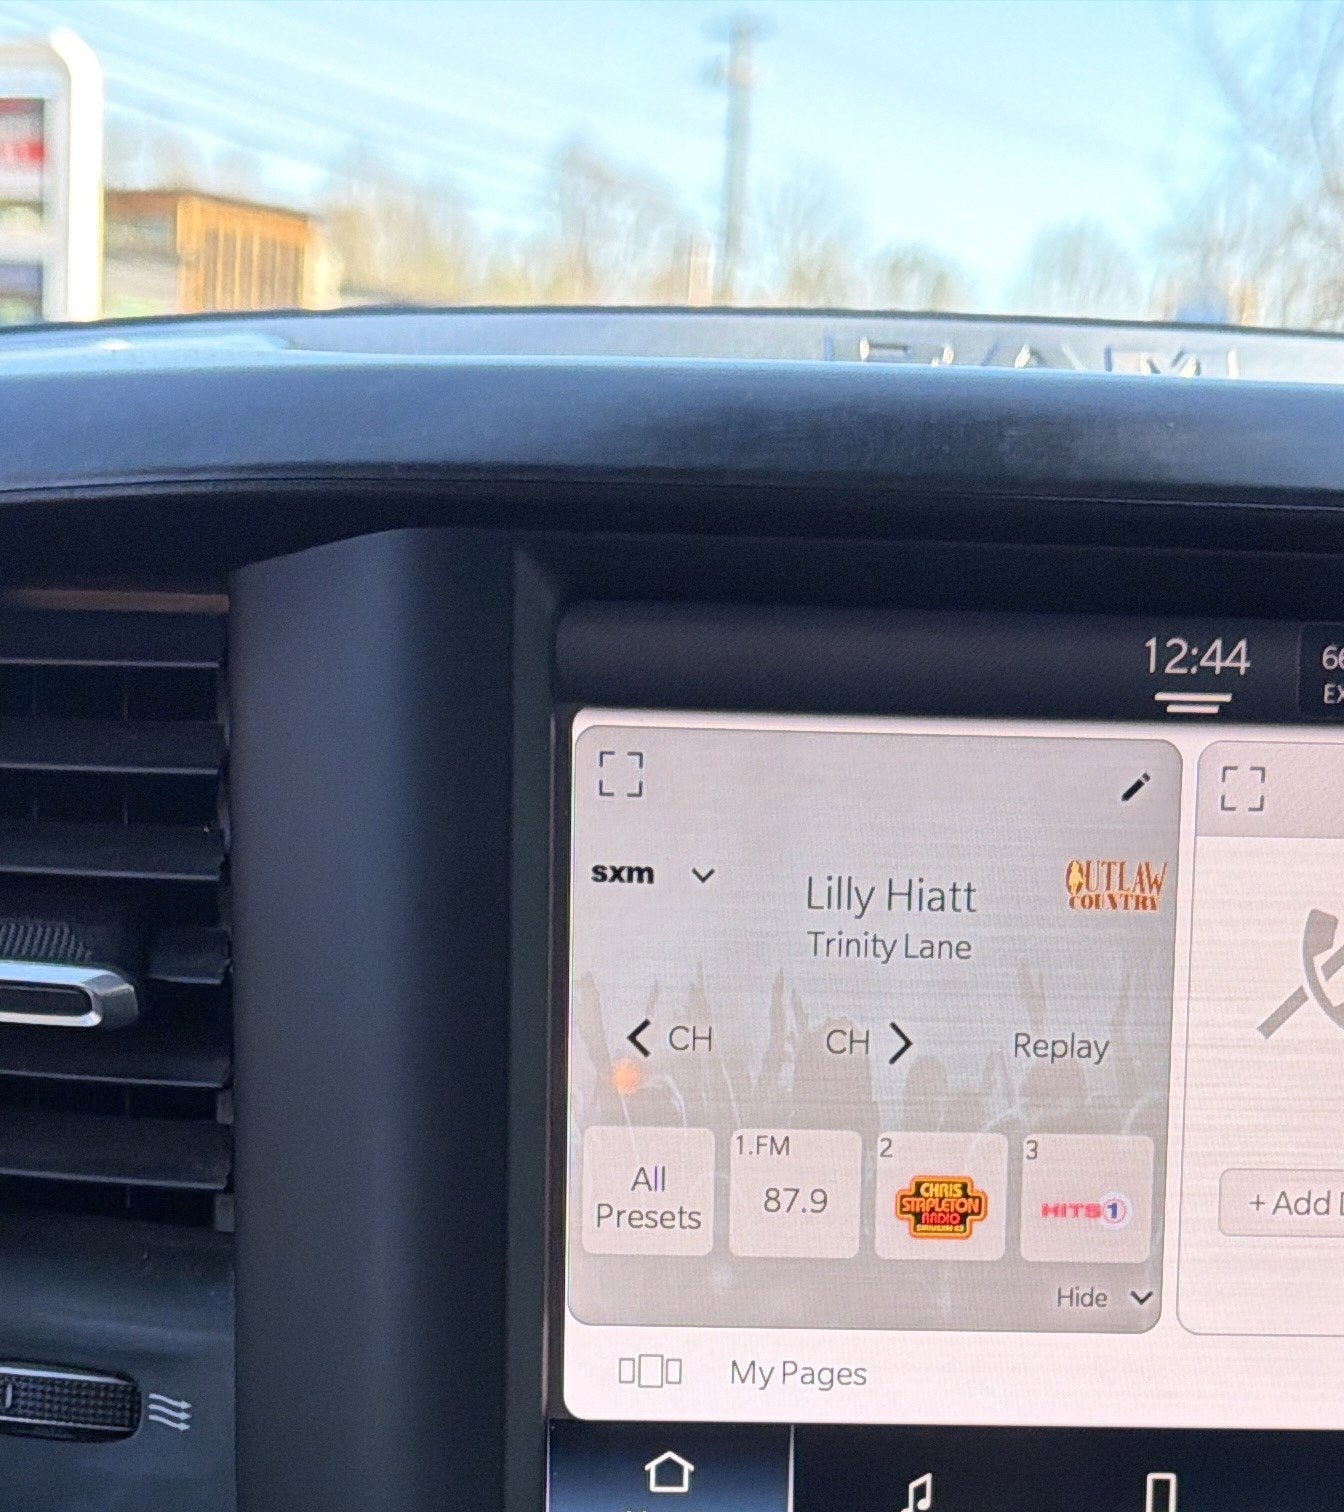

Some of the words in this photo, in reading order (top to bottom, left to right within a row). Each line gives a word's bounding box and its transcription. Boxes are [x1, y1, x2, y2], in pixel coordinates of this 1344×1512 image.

[1143, 637, 1252, 677] 12:44
[590, 863, 655, 885] sxm
[1064, 859, 1169, 896] OUTLAW
[806, 875, 876, 920] Lilly
[887, 877, 978, 914] Hiatt
[1067, 892, 1160, 912] COUNTRY
[807, 930, 898, 965] Trinity
[904, 931, 973, 961] Lane
[667, 1026, 714, 1052] CH
[825, 1029, 871, 1056] CH
[1013, 1031, 1111, 1065] Replay
[734, 1135, 792, 1158] 1.FM
[879, 1137, 894, 1159] 2
[1024, 1139, 1040, 1161] 3
[630, 1165, 666, 1193] All
[919, 1182, 963, 1199] CHRIS
[763, 1187, 829, 1214] 87.9
[1271, 1190, 1331, 1216] Add
[595, 1202, 702, 1232] Presets
[1056, 1286, 1109, 1310] Hide
[730, 1360, 776, 1393] My
[781, 1361, 868, 1389] Pages
